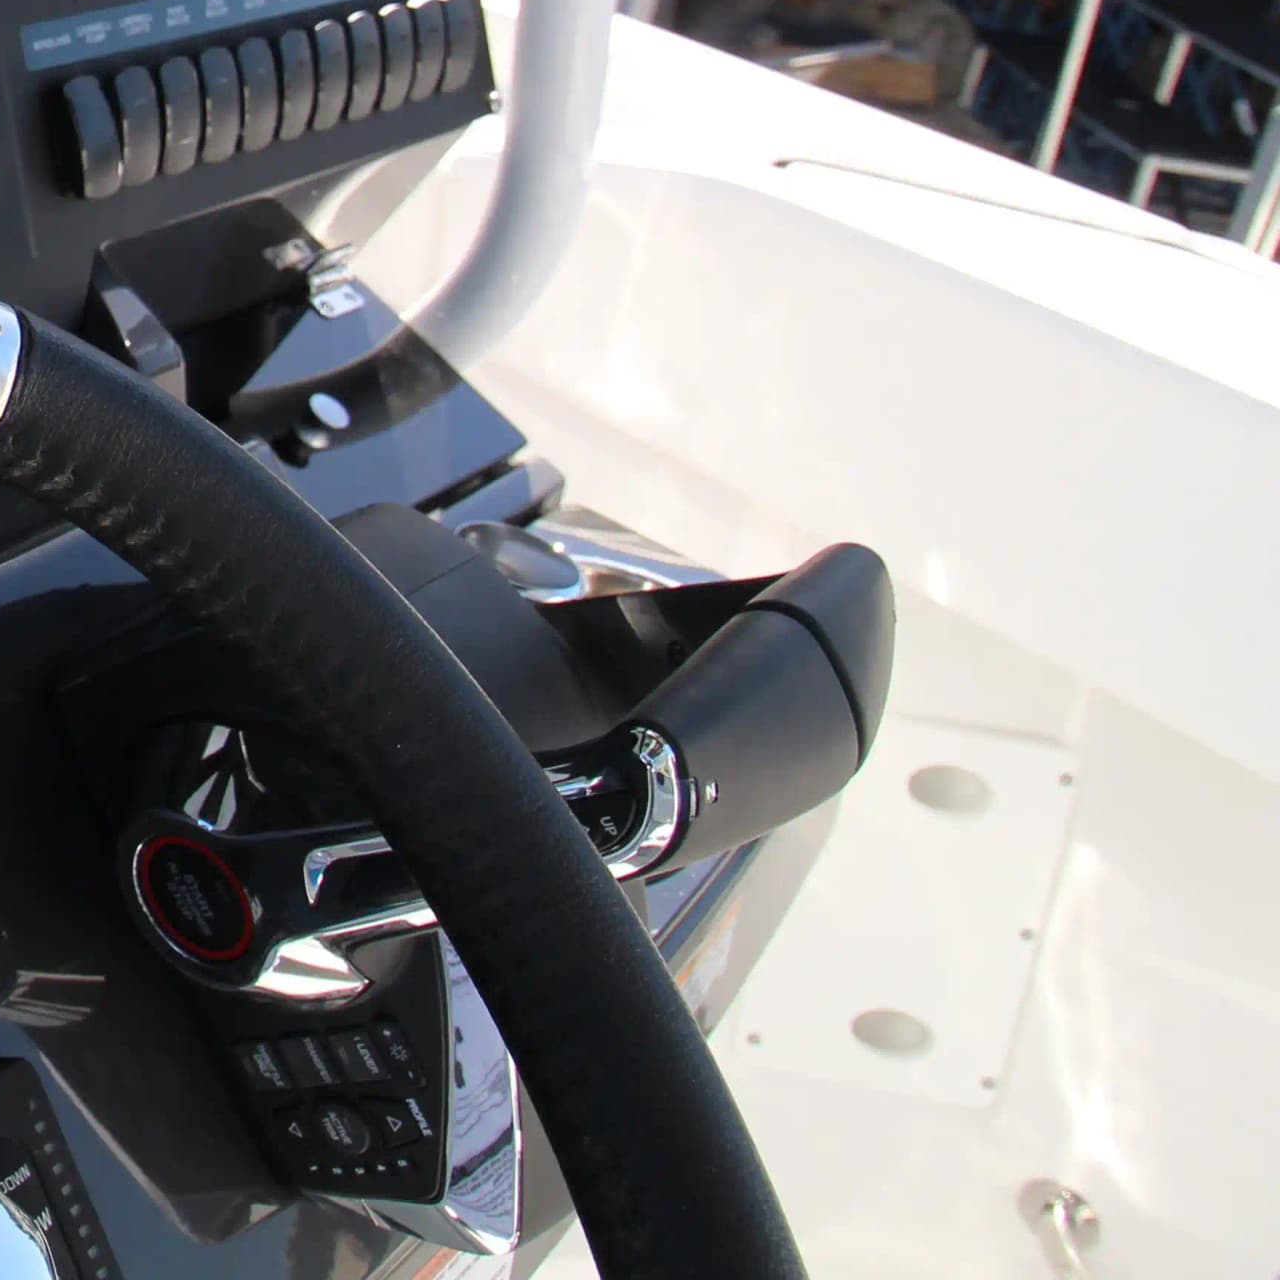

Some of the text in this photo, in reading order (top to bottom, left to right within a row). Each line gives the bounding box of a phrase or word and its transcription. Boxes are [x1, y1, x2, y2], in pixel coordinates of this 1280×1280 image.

[599, 816, 619, 836] UP
[303, 1037, 333, 1084] TRANSFER
[356, 1043, 380, 1074] LEVER
[405, 1098, 433, 1137] PROFILE
